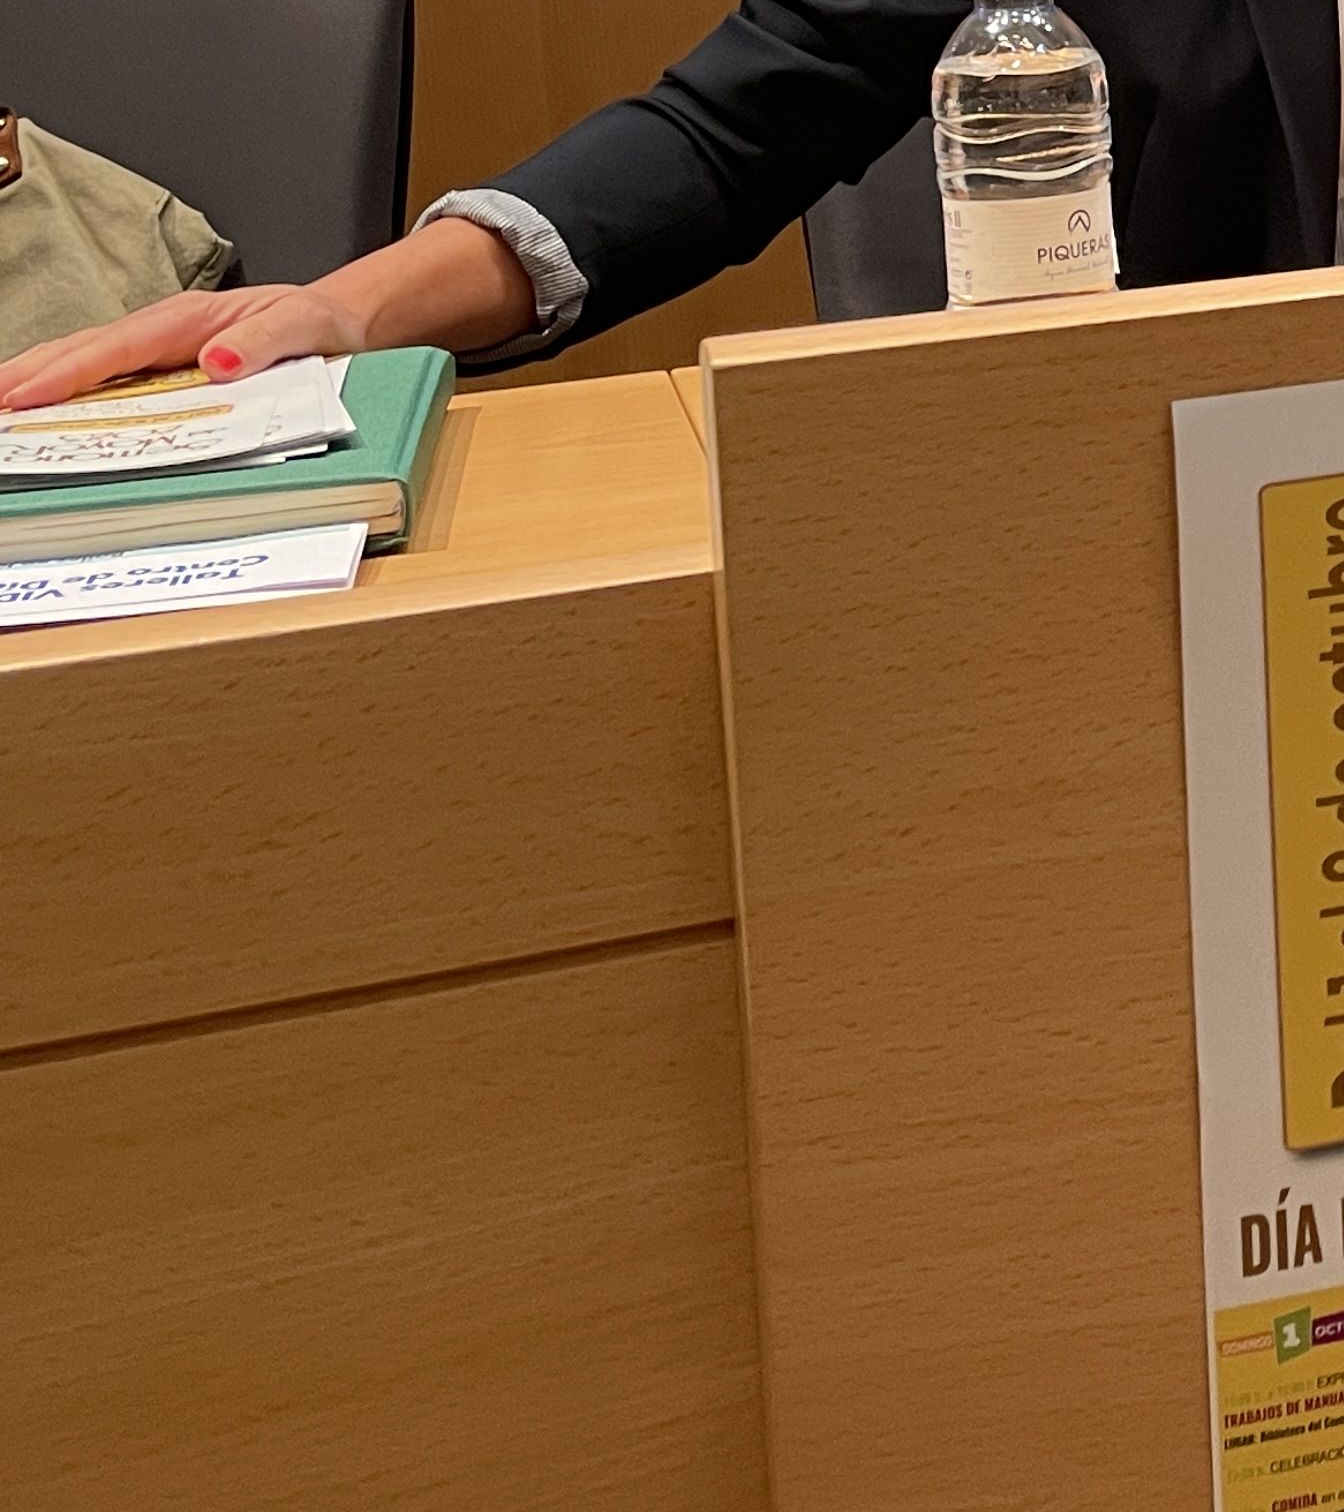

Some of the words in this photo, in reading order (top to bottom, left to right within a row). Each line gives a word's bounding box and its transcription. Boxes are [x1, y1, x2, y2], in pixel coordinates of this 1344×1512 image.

[1038, 233, 1110, 264] PIQUERAS
[126, 555, 268, 575] Centro
[62, 571, 113, 584] de
[79, 568, 243, 590] Talleres
[1240, 1186, 1326, 1278] DÍA
[1282, 1322, 1301, 1348] 1
[1224, 1400, 1282, 1428] TRABAJOS
[1286, 1397, 1300, 1416] DE
[1272, 1492, 1318, 1512] COMIDA
[1321, 1490, 1335, 1503] en
